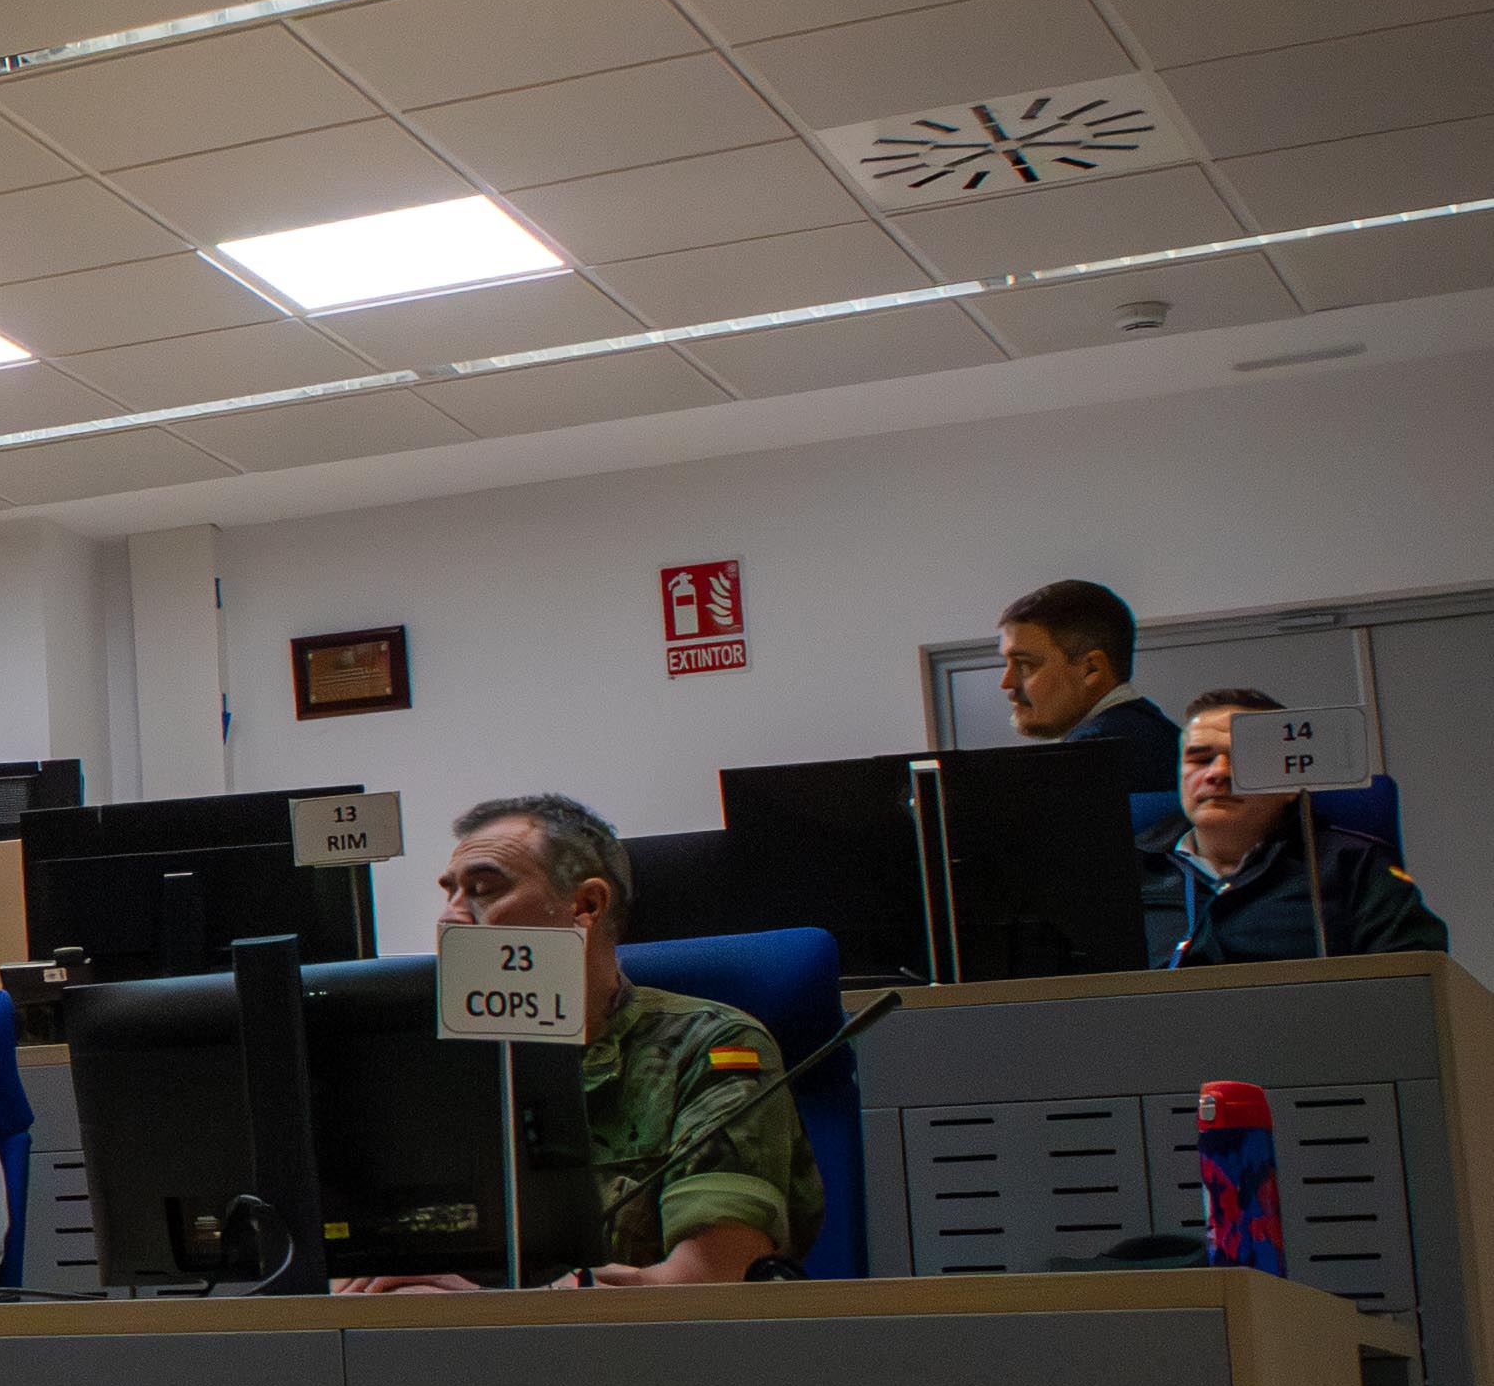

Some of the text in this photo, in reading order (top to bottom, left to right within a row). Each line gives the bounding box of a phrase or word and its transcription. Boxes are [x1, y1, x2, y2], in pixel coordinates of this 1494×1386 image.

[668, 643, 745, 673] EXTINTOR
[1282, 721, 1313, 741] 14
[1284, 754, 1314, 774] FP
[333, 805, 357, 823] 13
[327, 832, 367, 852] RIM
[500, 944, 533, 971] 23
[465, 990, 566, 1026] COPS_L
